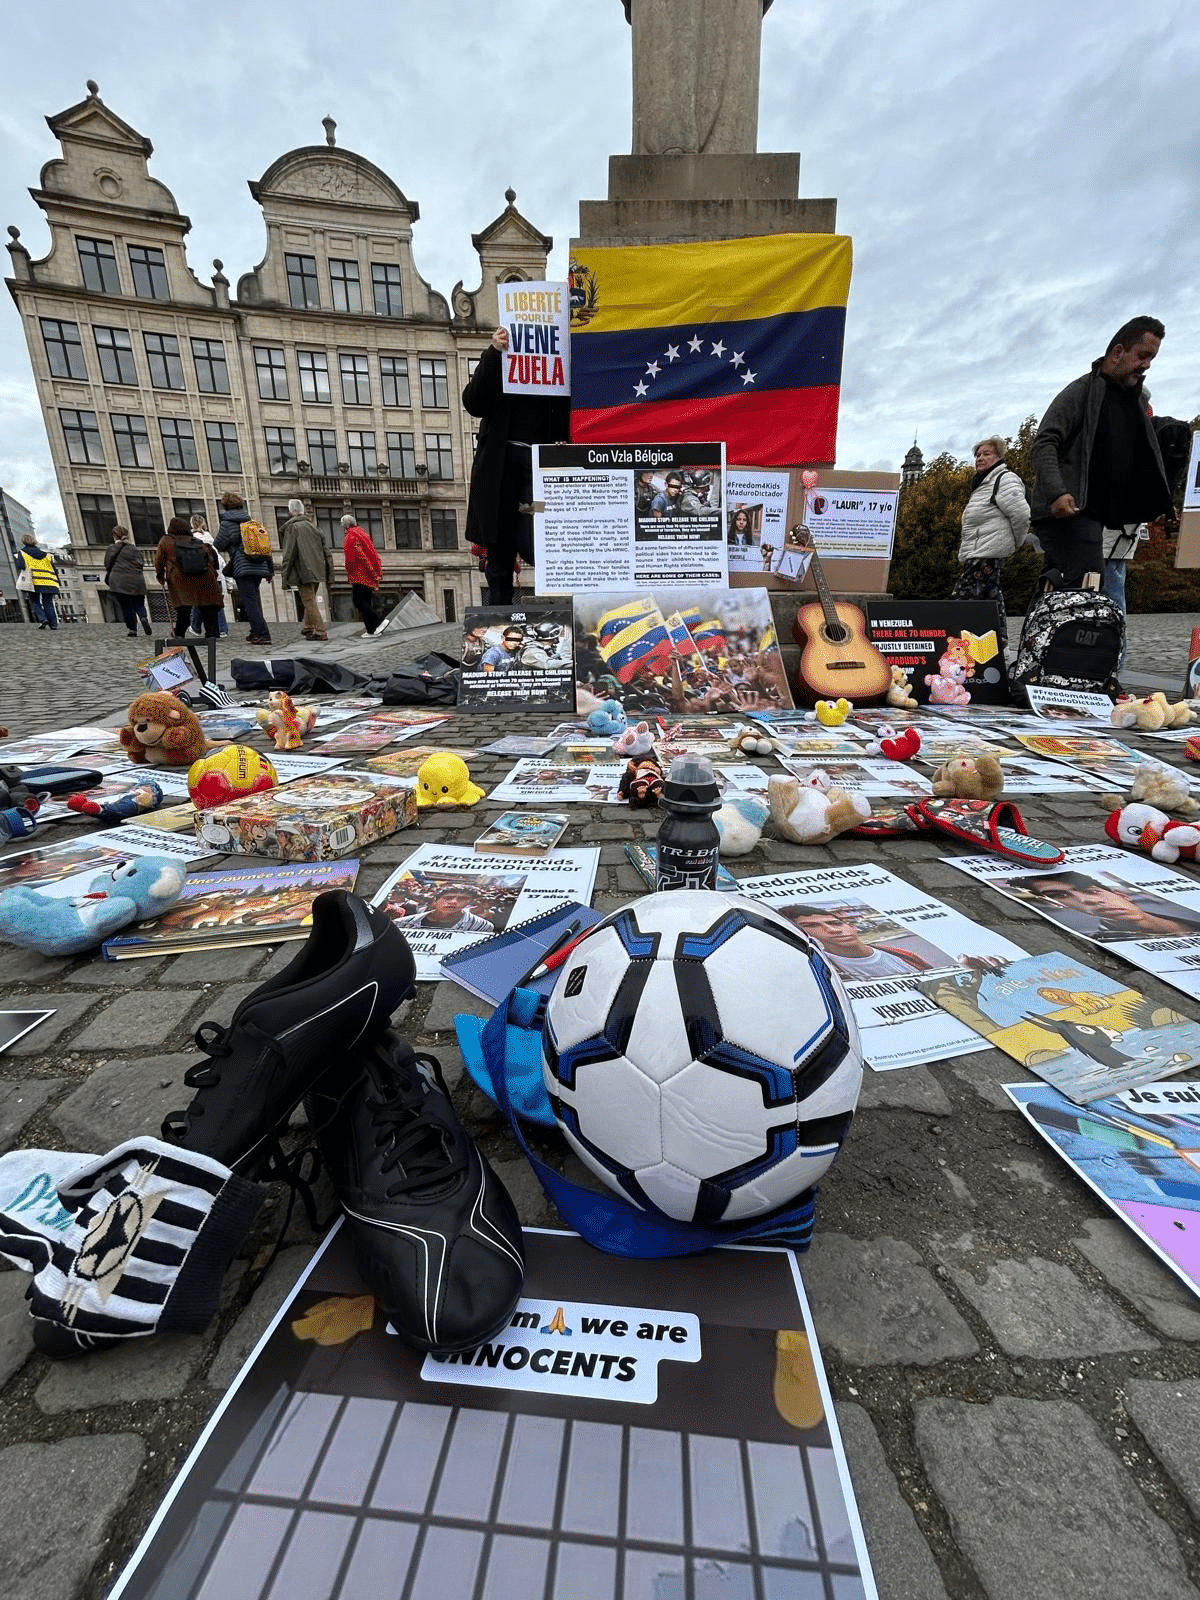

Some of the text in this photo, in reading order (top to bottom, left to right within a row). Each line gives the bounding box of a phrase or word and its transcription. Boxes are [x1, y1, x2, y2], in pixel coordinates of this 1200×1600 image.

[505, 288, 561, 313] LIBERTÉ
[543, 314, 553, 322] LE
[510, 323, 559, 355] VENE
[507, 354, 564, 385] ZUELA
[588, 450, 673, 465] Con Vzla Bélgica
[880, 502, 892, 513] y/o
[1075, 629, 1100, 646] CAT
[1032, 694, 1110, 707] #MaduroDictador
[1034, 689, 1104, 702] #Freedom4Kids
[999, 831, 1045, 850] MARVEL
[430, 855, 575, 865] #Freedom4Kids
[214, 873, 276, 884] journée
[298, 867, 333, 875] forêt
[419, 861, 583, 876] #MaduroDictador
[738, 867, 869, 890] reedom4Kids
[884, 905, 929, 917] Manuel
[919, 912, 948, 921] años
[426, 931, 453, 942] PARA
[872, 999, 939, 1019] VENEZUEL
[1128, 1089, 1161, 1103] Je
[581, 1317, 628, 1336] we
[636, 1319, 688, 1343] are
